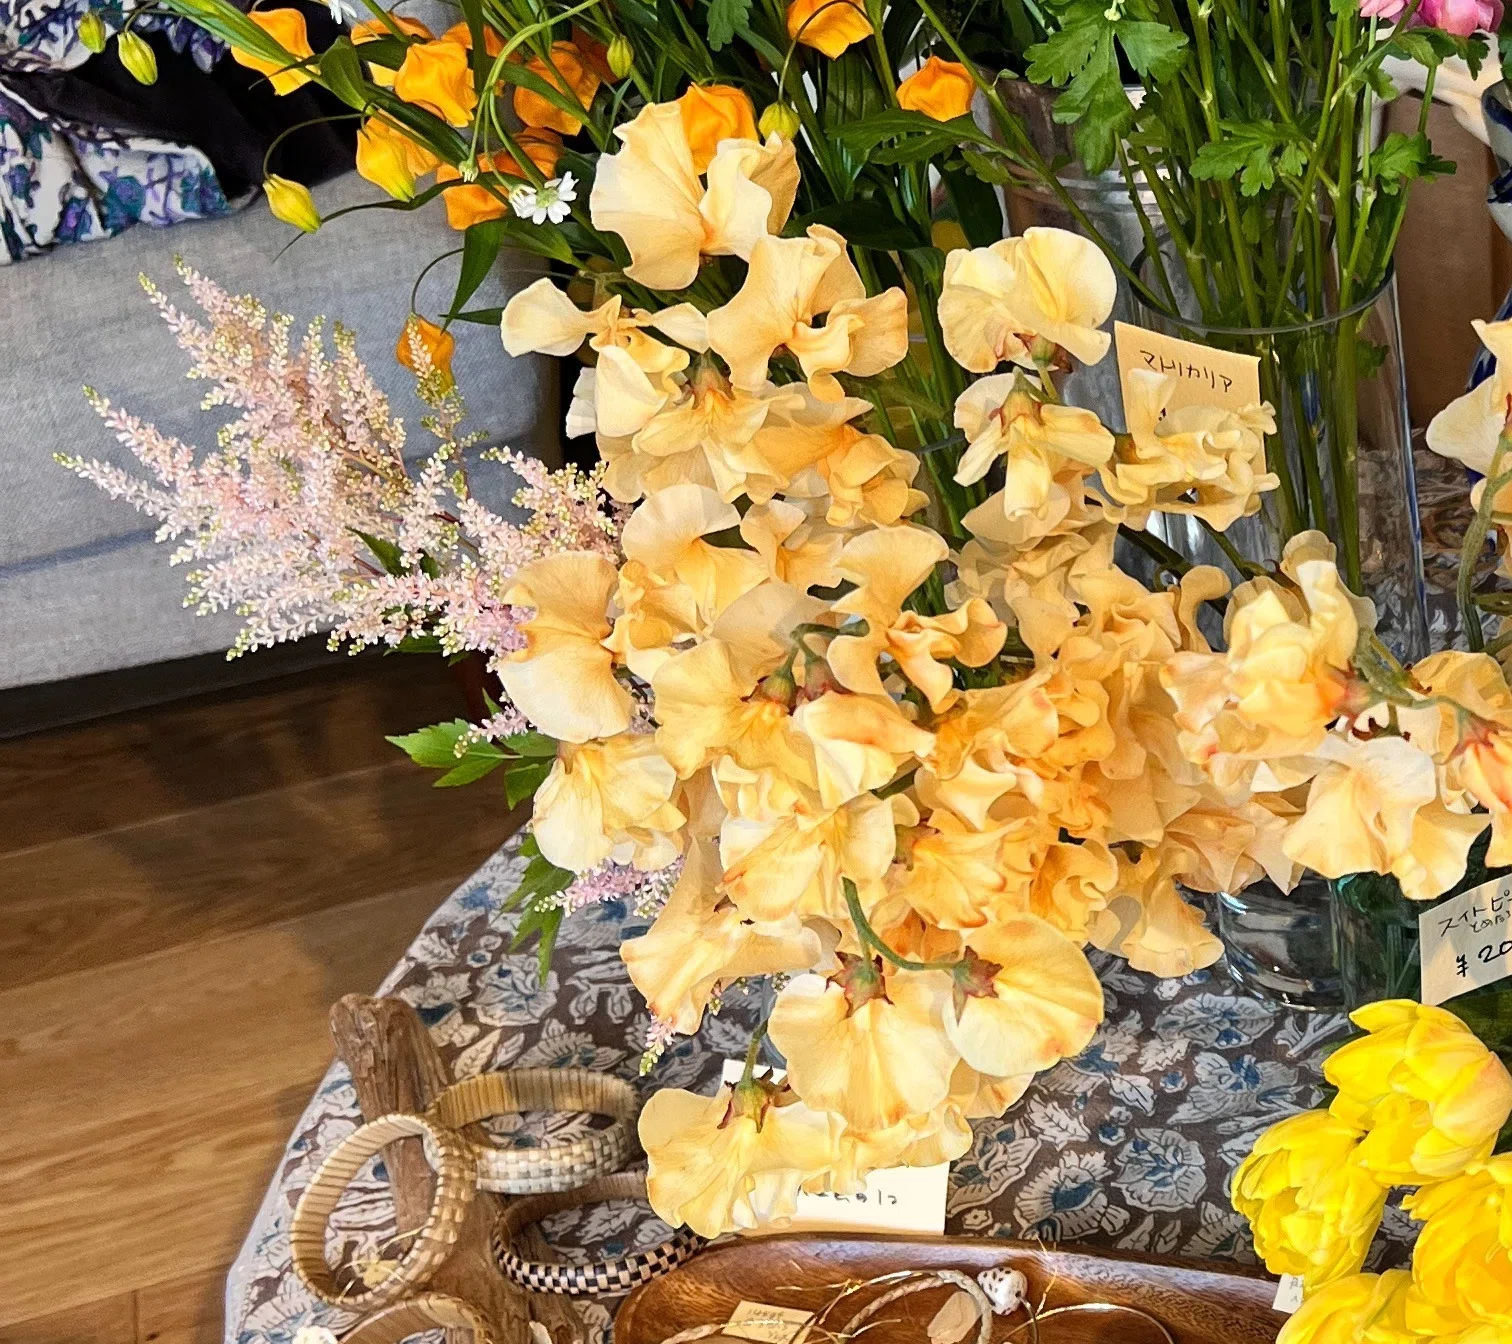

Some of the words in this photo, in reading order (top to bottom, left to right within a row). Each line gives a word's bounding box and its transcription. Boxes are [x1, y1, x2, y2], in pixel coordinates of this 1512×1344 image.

[1140, 350, 1233, 393] マトリカリア
